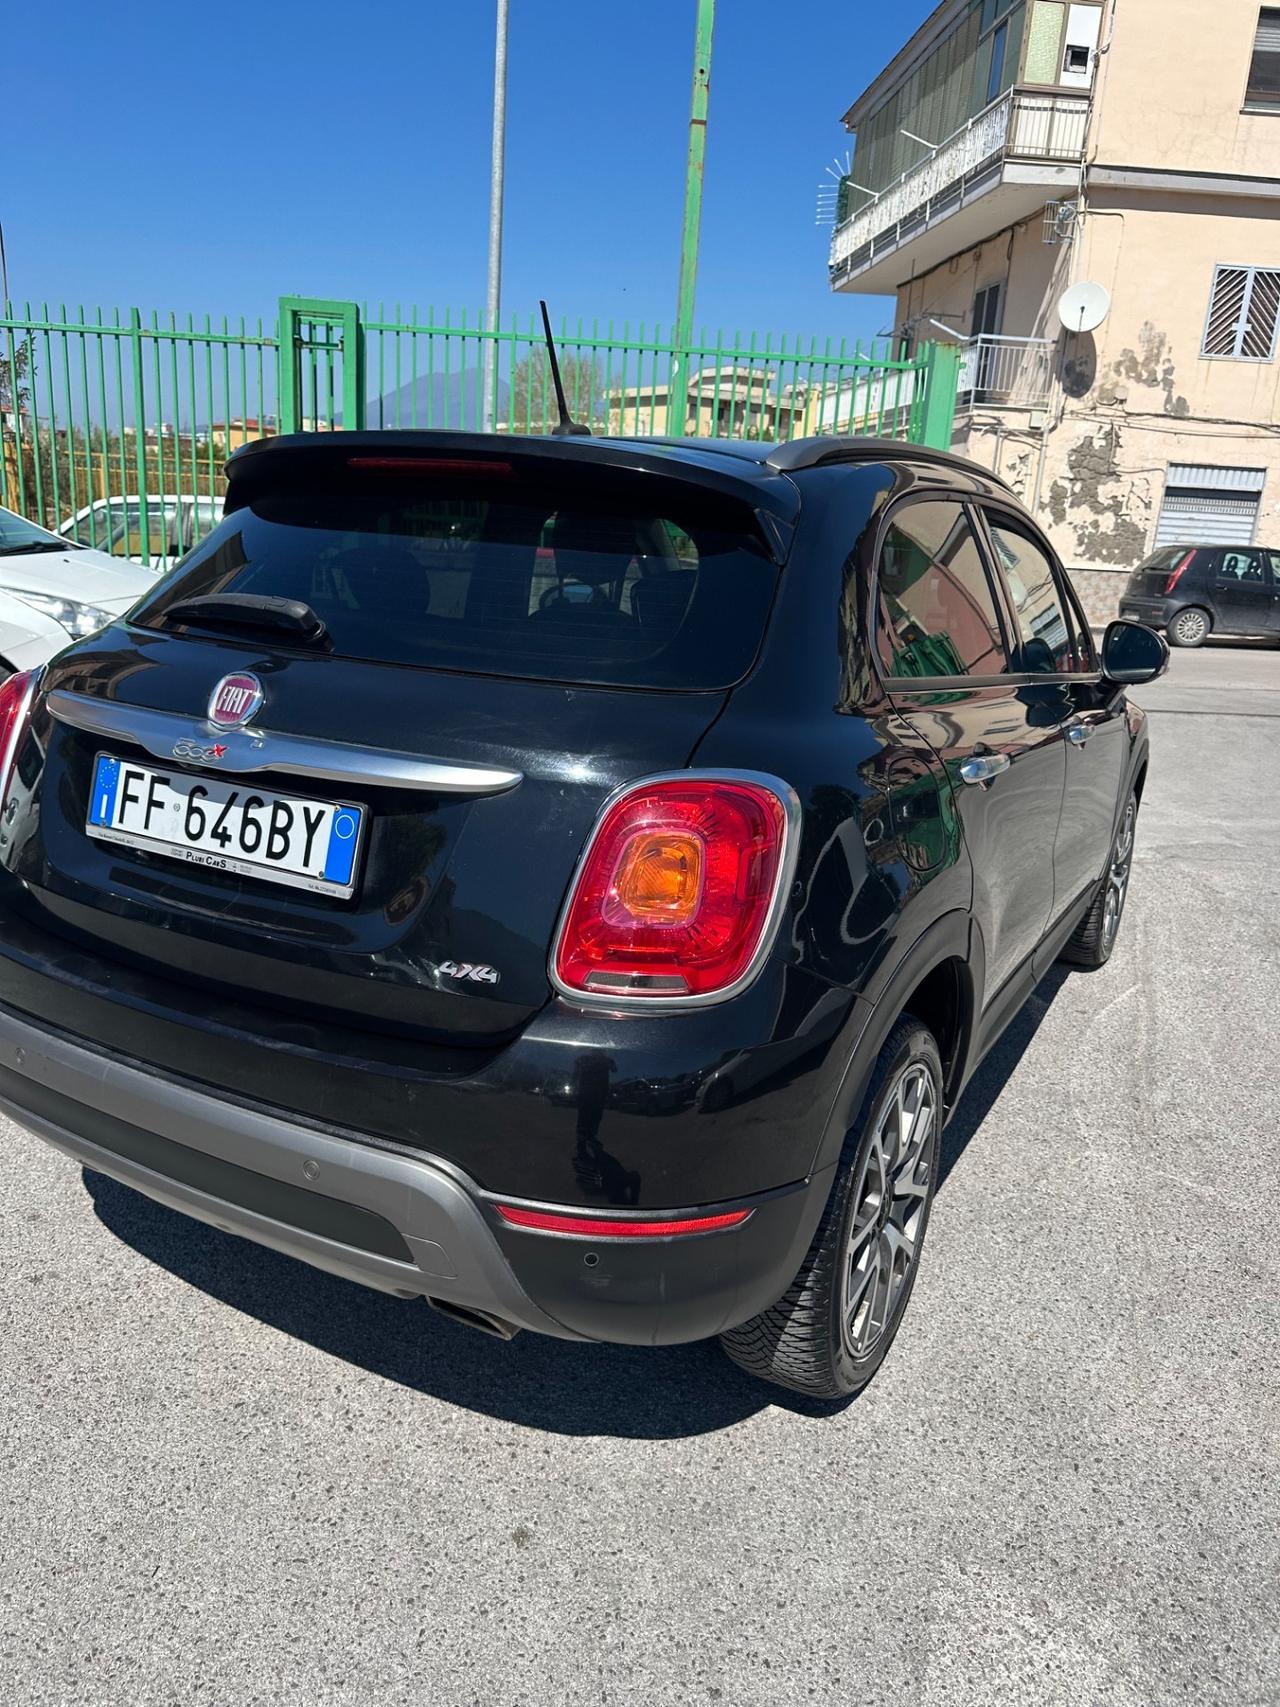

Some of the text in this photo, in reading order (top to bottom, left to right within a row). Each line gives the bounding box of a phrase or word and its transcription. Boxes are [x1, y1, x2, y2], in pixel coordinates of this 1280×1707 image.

[216, 684, 253, 714] FIAT
[118, 769, 327, 868] FF 646BY
